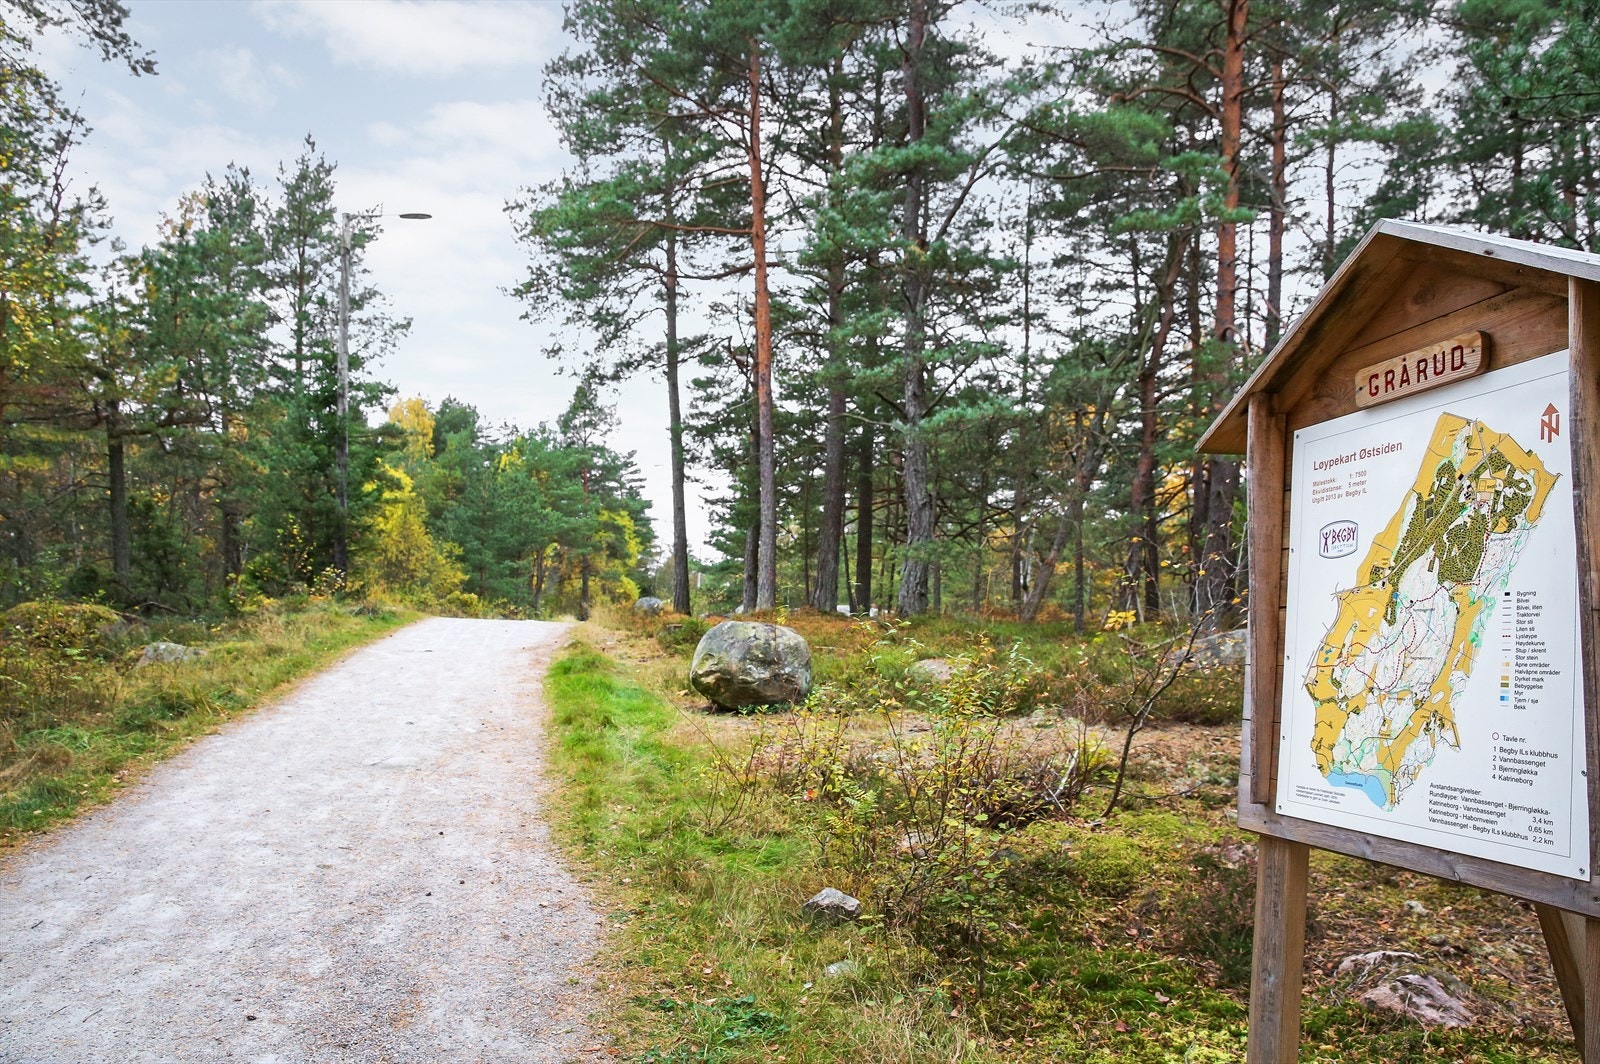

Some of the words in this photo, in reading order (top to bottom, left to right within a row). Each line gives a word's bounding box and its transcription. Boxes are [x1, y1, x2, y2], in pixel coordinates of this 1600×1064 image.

[1368, 344, 1467, 398] GRÅRUD
[1313, 452, 1357, 471] Løypekart
[1359, 442, 1403, 460] Østsiden
[1325, 493, 1337, 502] 2013
[1345, 490, 1361, 498] Begby
[1332, 526, 1356, 545] BEGBY
[1503, 734, 1518, 743] Tavle
[1499, 746, 1518, 756] Begby
[1530, 750, 1558, 759] klubbhus
[1499, 756, 1546, 768] Vannbassenget
[1498, 765, 1538, 776] Bjerringløkka
[1498, 774, 1533, 786] Katrineborg
[1429, 782, 1482, 796] Avstandsangivelser:
[1429, 791, 1459, 801] Rundløype:
[1460, 795, 1504, 808] Vannbassenget
[1429, 799, 1459, 810] Katrineborg
[1463, 805, 1506, 818] Vannbassenget
[1429, 808, 1459, 819] Katrineborg
[1528, 825, 1542, 833] 0,65
[1543, 827, 1554, 835] km
[1428, 816, 1468, 829] Vannbassenget
[1473, 824, 1490, 834] Begby
[1501, 830, 1528, 841] klubbhus
[1532, 835, 1543, 843] 2,2
